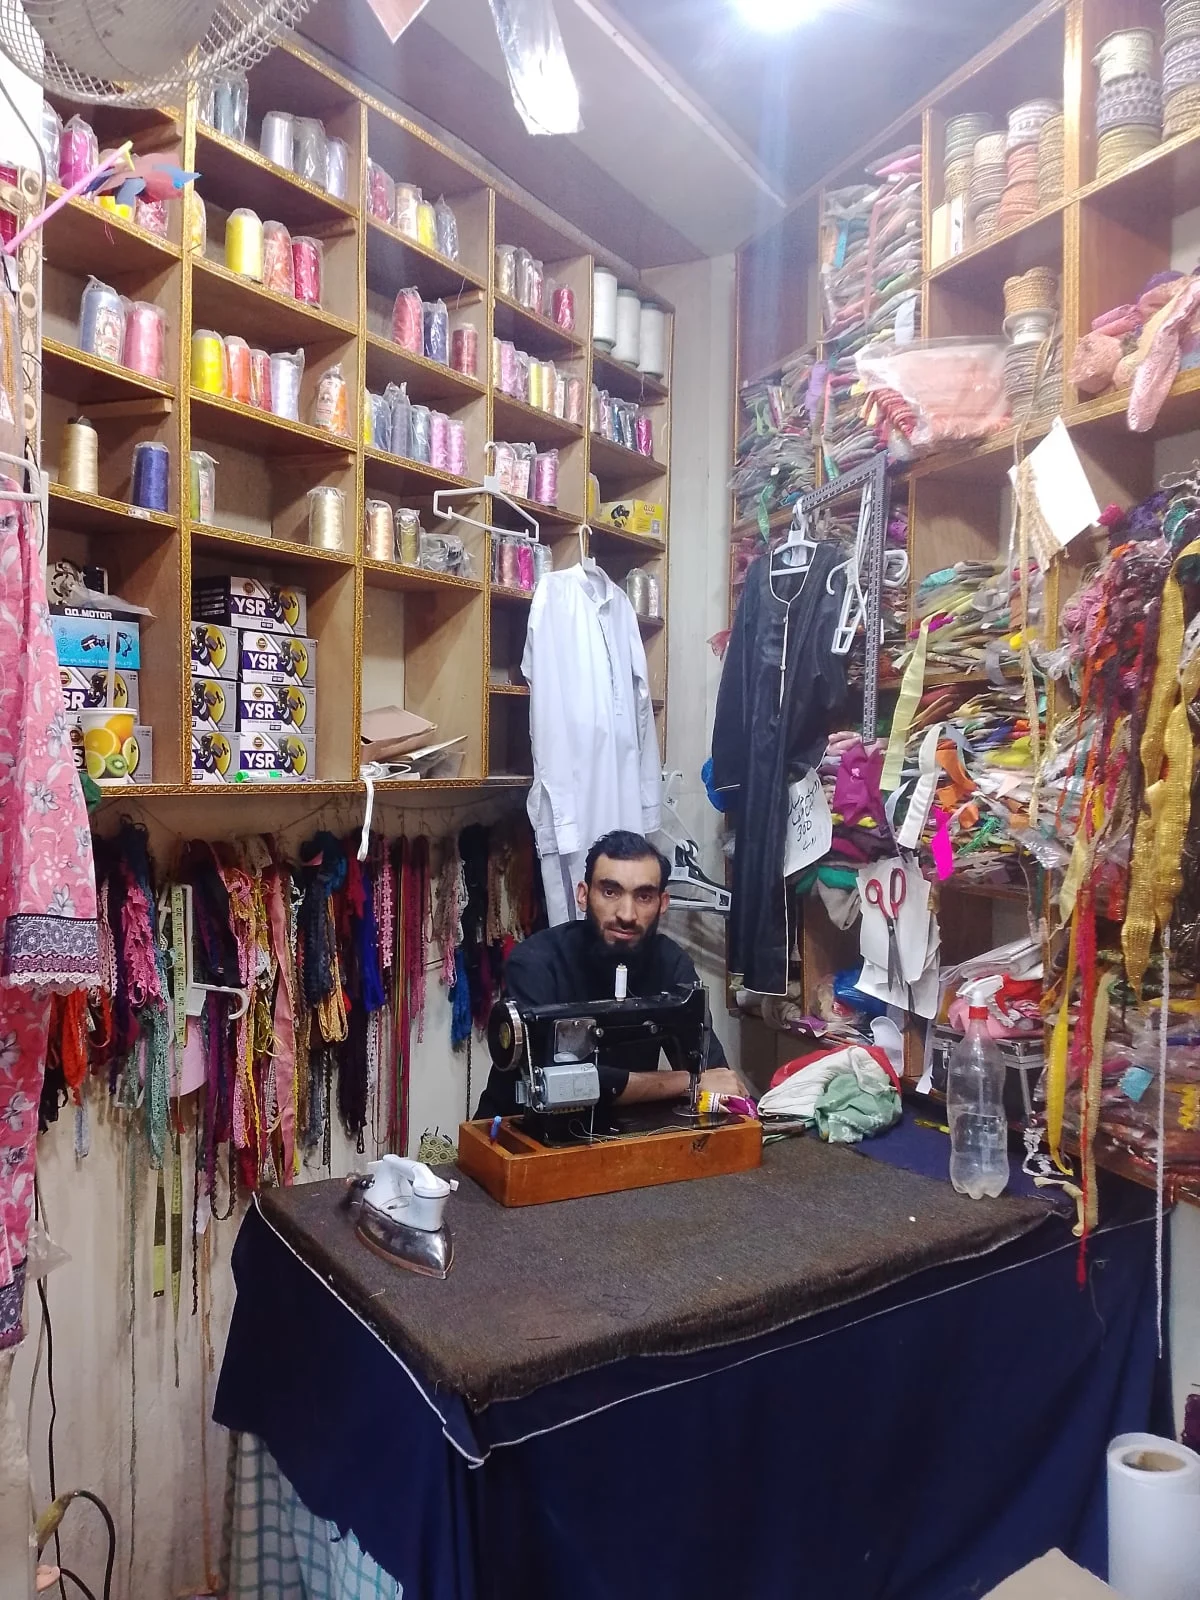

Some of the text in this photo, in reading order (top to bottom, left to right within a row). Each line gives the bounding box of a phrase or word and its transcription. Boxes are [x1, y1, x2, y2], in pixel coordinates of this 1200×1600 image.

[233, 596, 266, 616] YSR
[247, 652, 278, 671] YSR
[62, 690, 86, 709] SR
[244, 702, 275, 719] YSR
[243, 752, 276, 768] YSR
